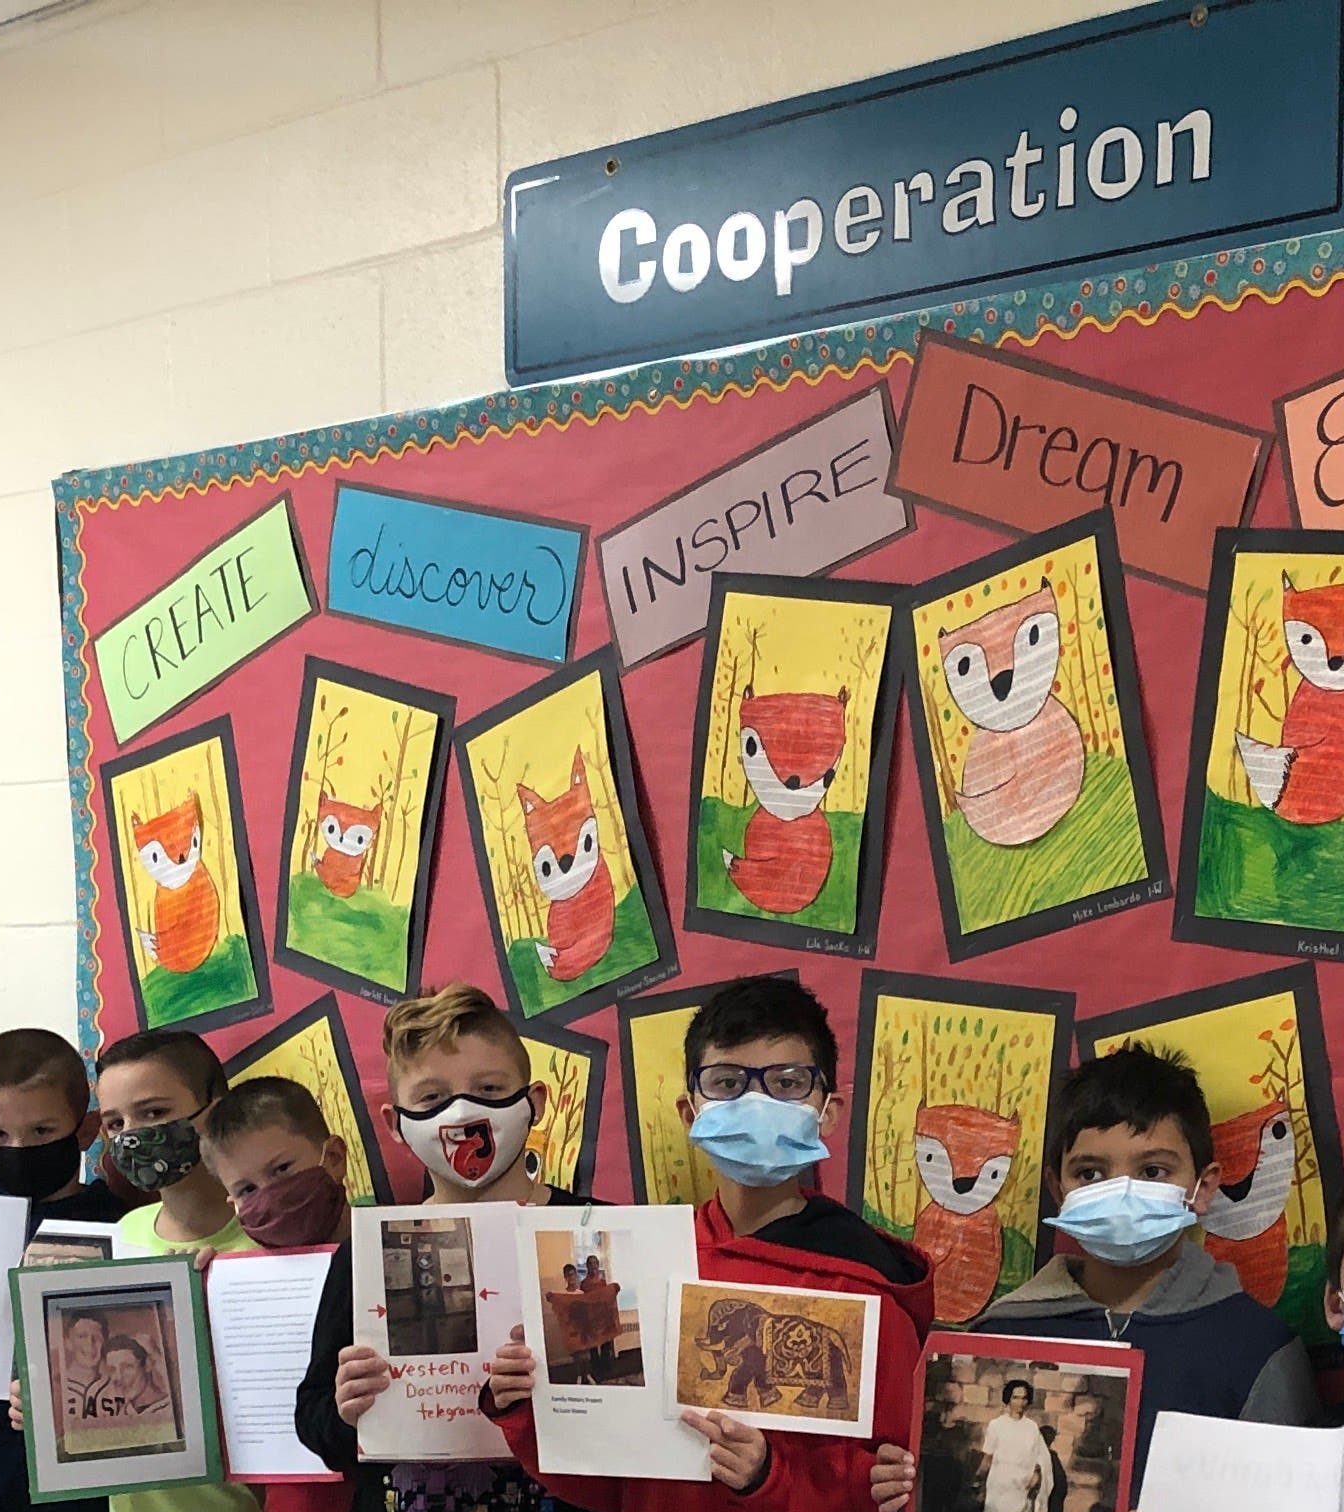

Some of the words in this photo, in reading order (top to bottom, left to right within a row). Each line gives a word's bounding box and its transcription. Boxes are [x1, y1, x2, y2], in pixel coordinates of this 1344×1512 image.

[598, 106, 1213, 303] Cooperation
[953, 384, 1188, 523] Dream
[348, 529, 569, 624] discover
[621, 440, 880, 616] INSPIRE
[120, 545, 269, 700] CREATE
[1072, 907, 1093, 922] Mike
[1097, 891, 1141, 912] Lombardo
